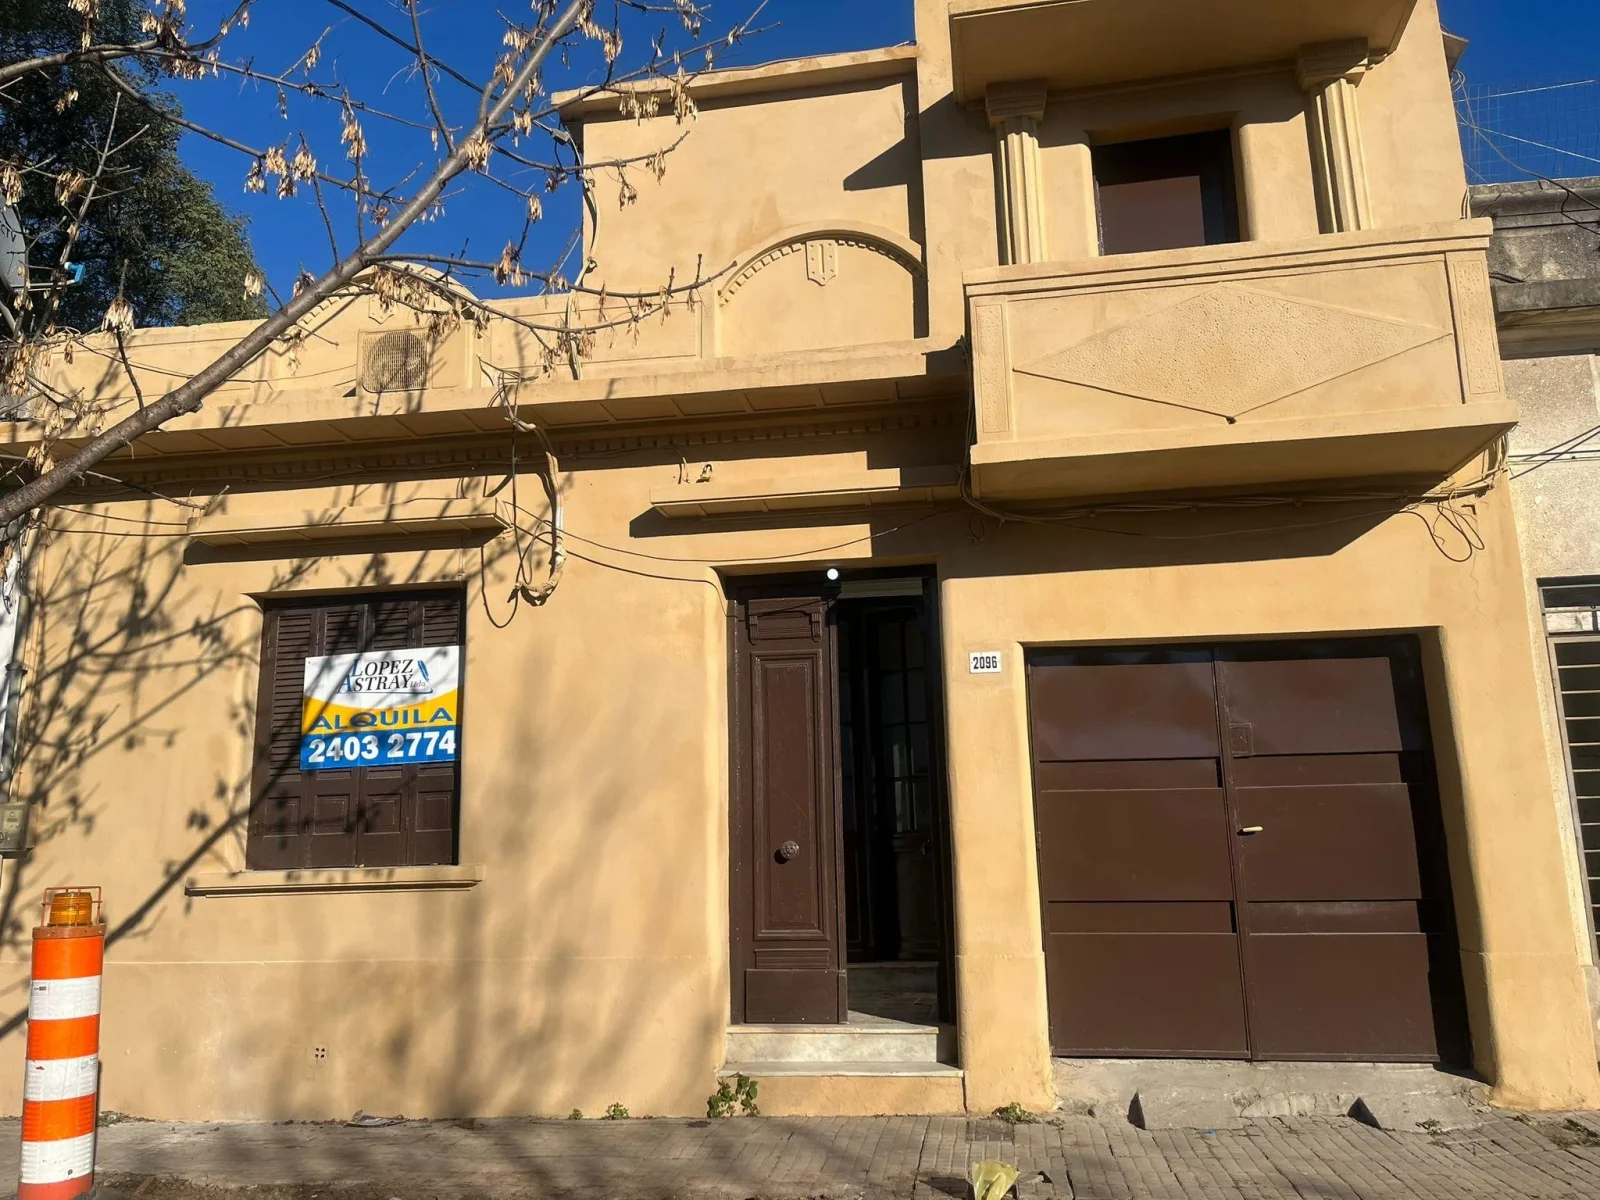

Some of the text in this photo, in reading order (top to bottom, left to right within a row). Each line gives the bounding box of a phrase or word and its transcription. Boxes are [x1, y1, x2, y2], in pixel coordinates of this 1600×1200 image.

[350, 658, 414, 677] LOPEZ
[973, 656, 997, 669] 2096
[338, 673, 414, 693] ASTRAY
[311, 707, 453, 730] ALQUILA
[308, 730, 456, 763] 2403 2774
